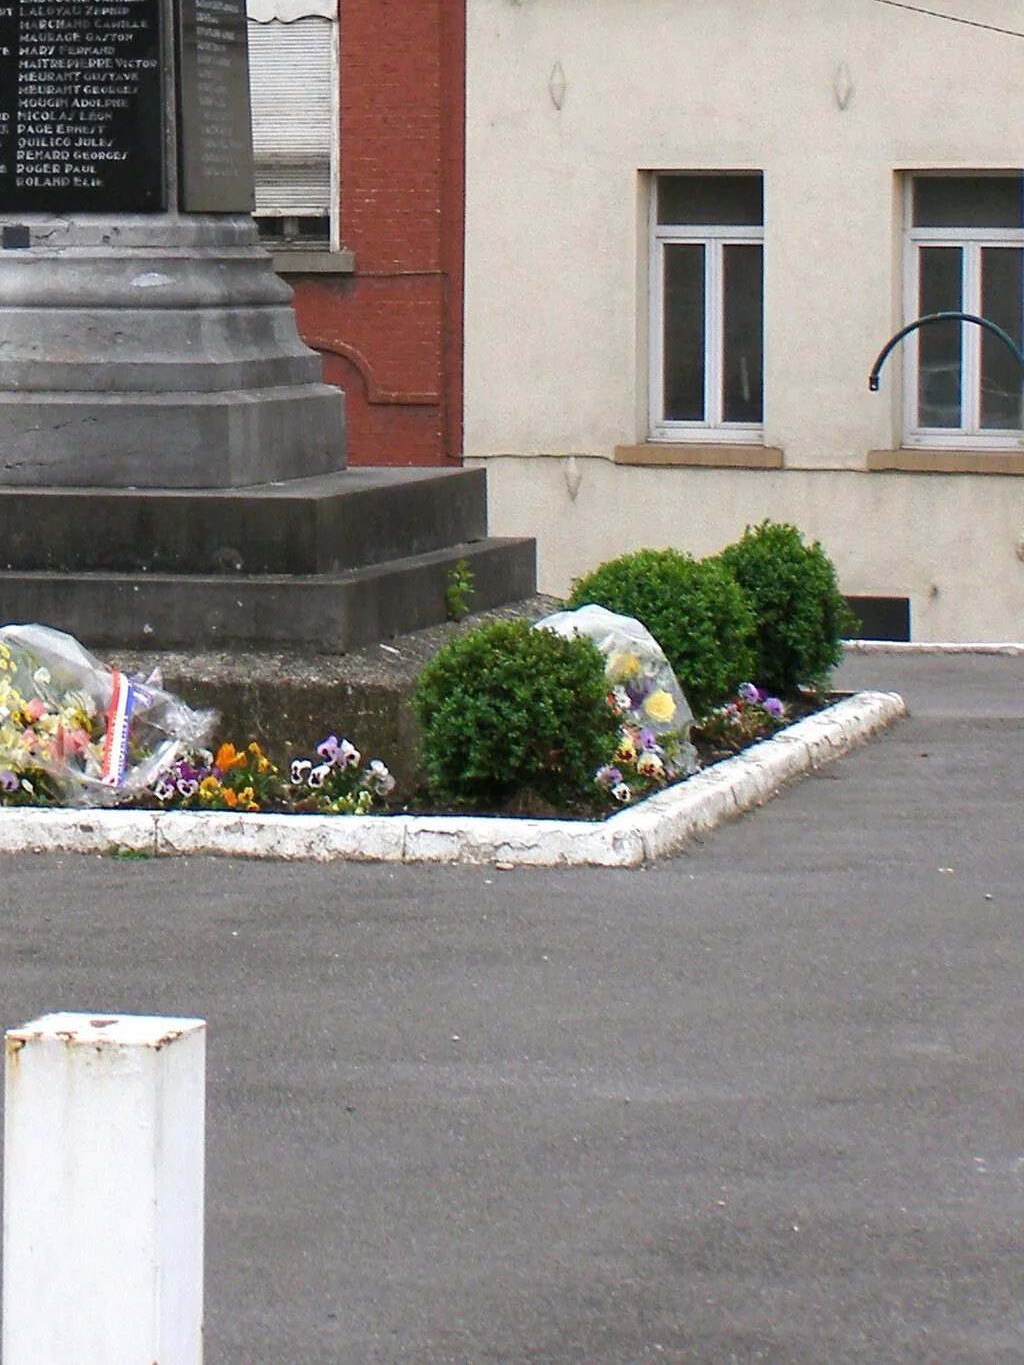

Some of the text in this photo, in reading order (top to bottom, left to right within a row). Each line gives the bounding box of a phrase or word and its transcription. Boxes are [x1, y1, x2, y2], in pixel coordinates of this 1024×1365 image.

[20, 20, 149, 29] MARCHAND CAMILLE
[86, 33, 133, 42] GASTON
[18, 72, 139, 81] MEURANT GUSTAVE
[18, 85, 139, 94] MEURANT GEORGES
[17, 111, 75, 121] NICOLAS
[56, 125, 106, 134] ERNEST
[74, 137, 116, 147] JULES
[16, 151, 128, 160] RENARD GEORGES
[16, 164, 96, 173] ROGER PAUL
[16, 177, 70, 186] ROLAND
